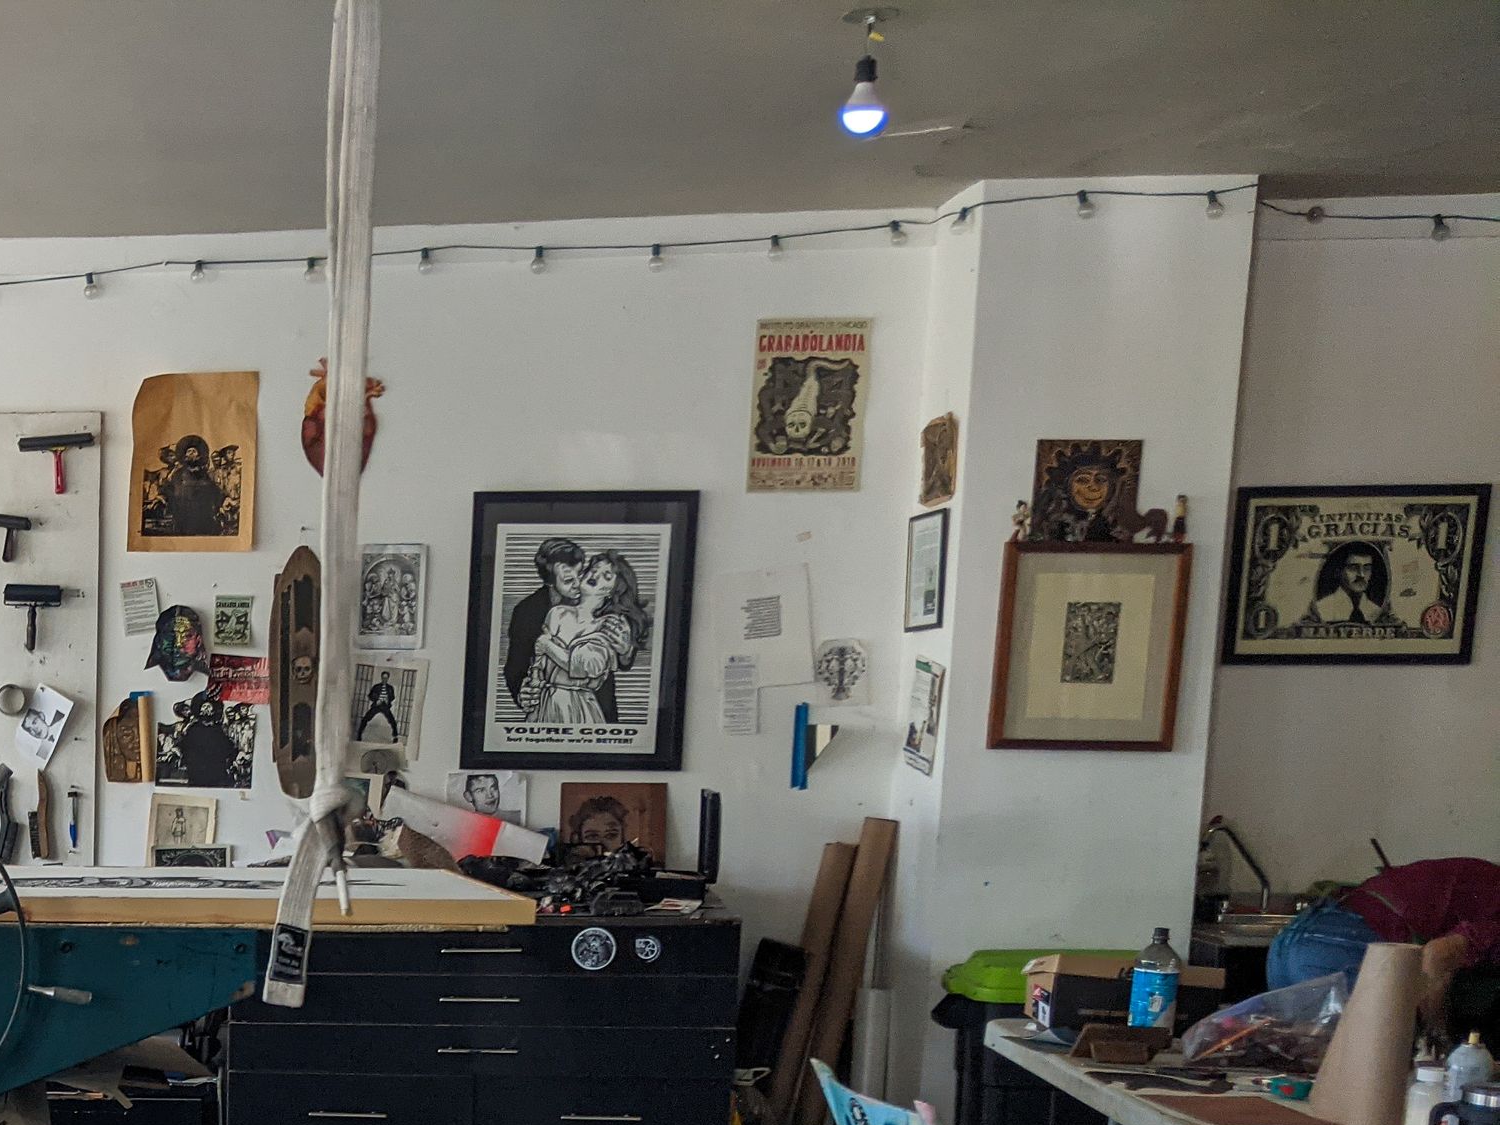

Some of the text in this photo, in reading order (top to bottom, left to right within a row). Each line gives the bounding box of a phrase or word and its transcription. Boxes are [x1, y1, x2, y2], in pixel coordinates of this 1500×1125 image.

[1307, 522, 1412, 539] GRACIAS
[503, 726, 638, 736] YOU'RE GOOD
